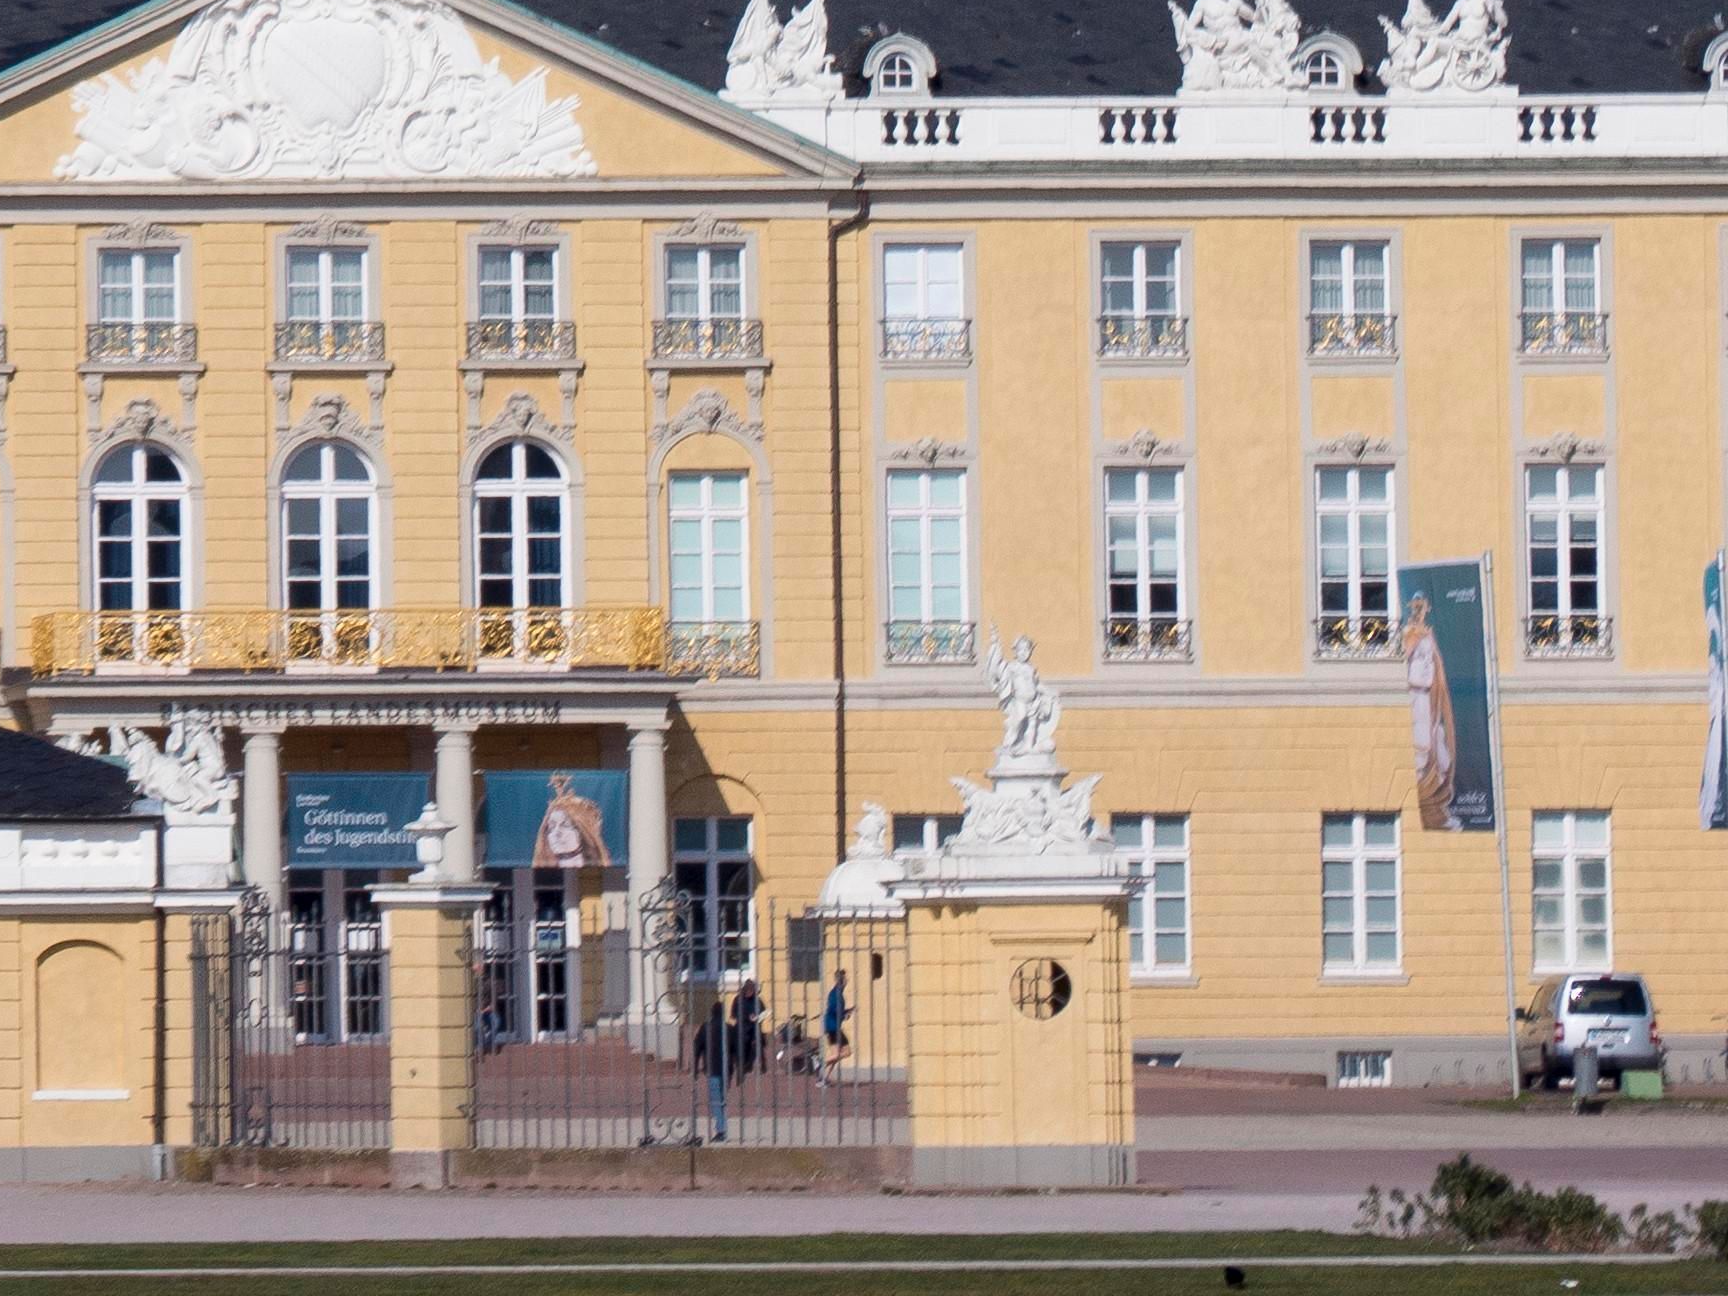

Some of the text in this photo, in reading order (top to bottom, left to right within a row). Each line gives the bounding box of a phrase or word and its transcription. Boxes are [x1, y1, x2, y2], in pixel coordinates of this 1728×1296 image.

[330, 700, 561, 720] LANDESMUSEUM
[304, 809, 387, 826] Göttinnen
[304, 828, 333, 844] des
